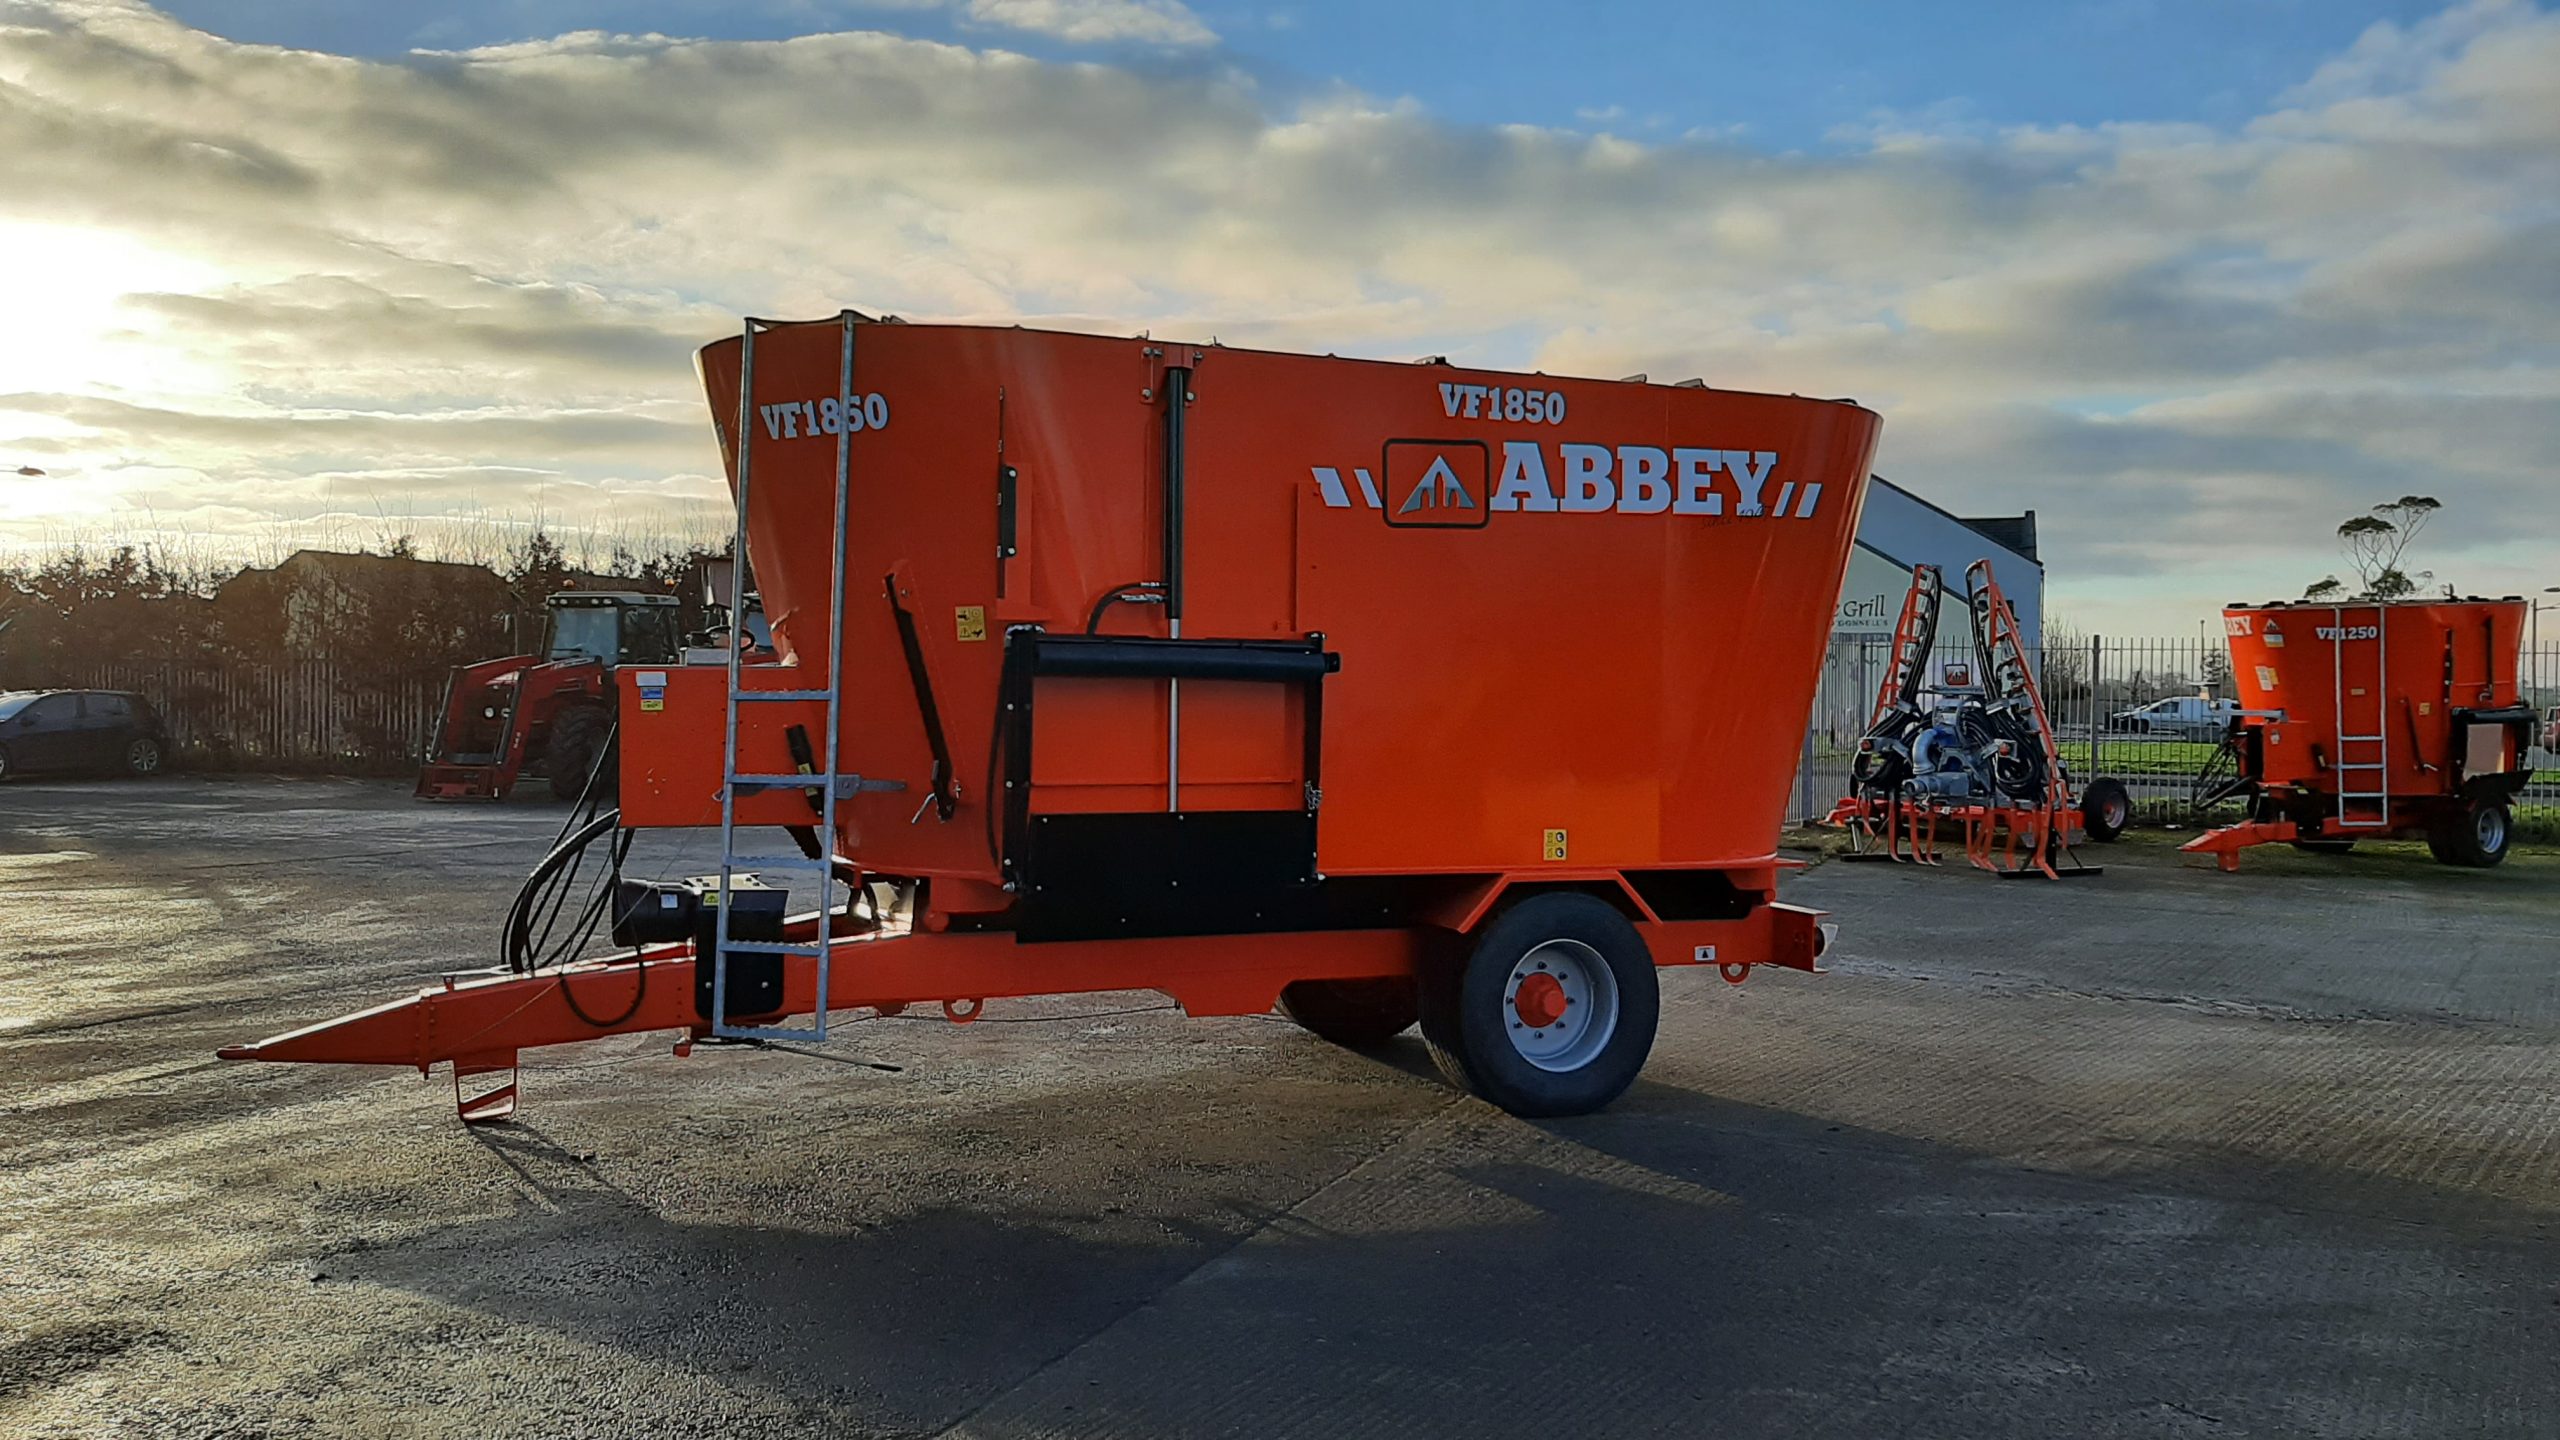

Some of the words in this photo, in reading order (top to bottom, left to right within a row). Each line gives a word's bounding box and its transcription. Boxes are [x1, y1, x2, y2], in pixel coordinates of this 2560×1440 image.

[760, 393, 888, 440] VF1850
[1438, 383, 1565, 425] VF1850
[1490, 442, 1777, 516] ABBEY
[1843, 594, 1885, 618] Grill
[2315, 626, 2378, 640] VF1250
